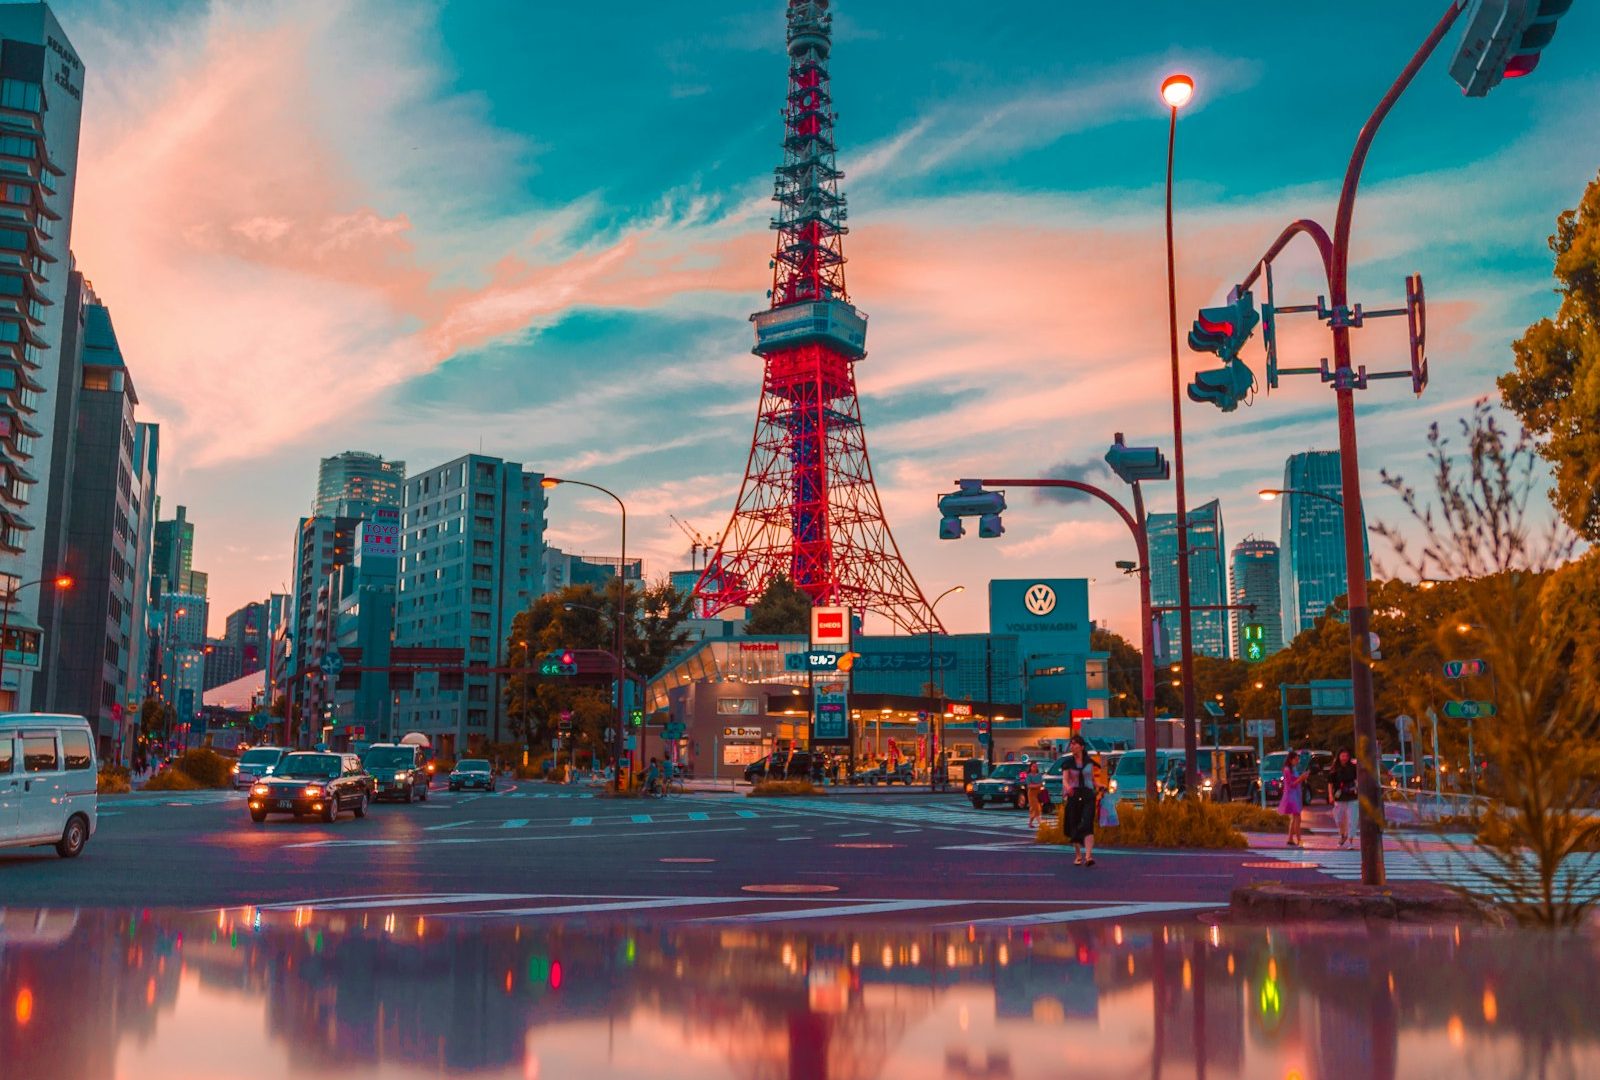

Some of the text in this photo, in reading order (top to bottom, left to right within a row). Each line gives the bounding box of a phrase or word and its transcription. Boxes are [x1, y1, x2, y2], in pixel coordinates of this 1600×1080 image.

[1006, 623, 1077, 632] VOLKSWAGEN
[809, 654, 836, 665] セルフ
